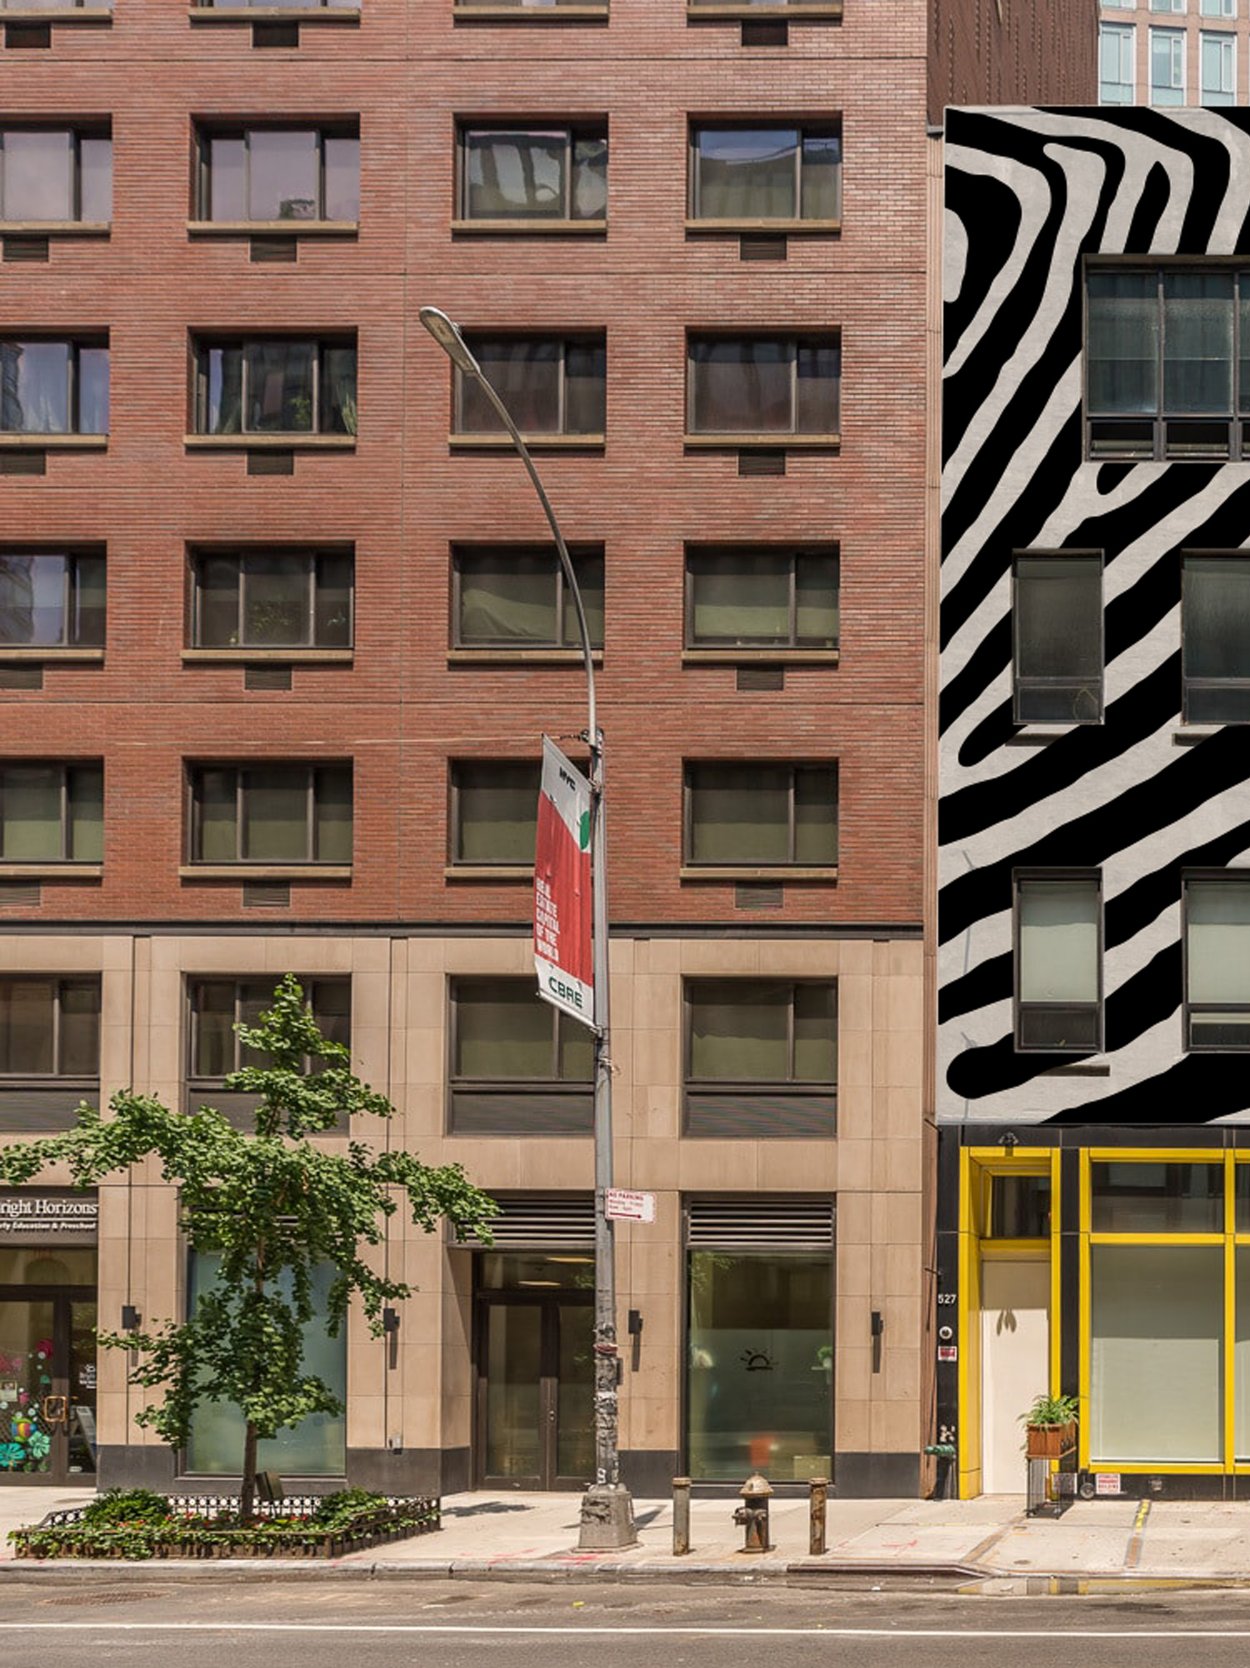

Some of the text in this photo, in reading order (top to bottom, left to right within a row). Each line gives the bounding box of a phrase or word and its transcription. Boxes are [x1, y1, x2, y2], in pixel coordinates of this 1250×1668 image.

[536, 890, 558, 919] ESTATE
[548, 976, 583, 1009] CBRE
[0, 1199, 97, 1217] right Horizons
[938, 1294, 957, 1304] 527
